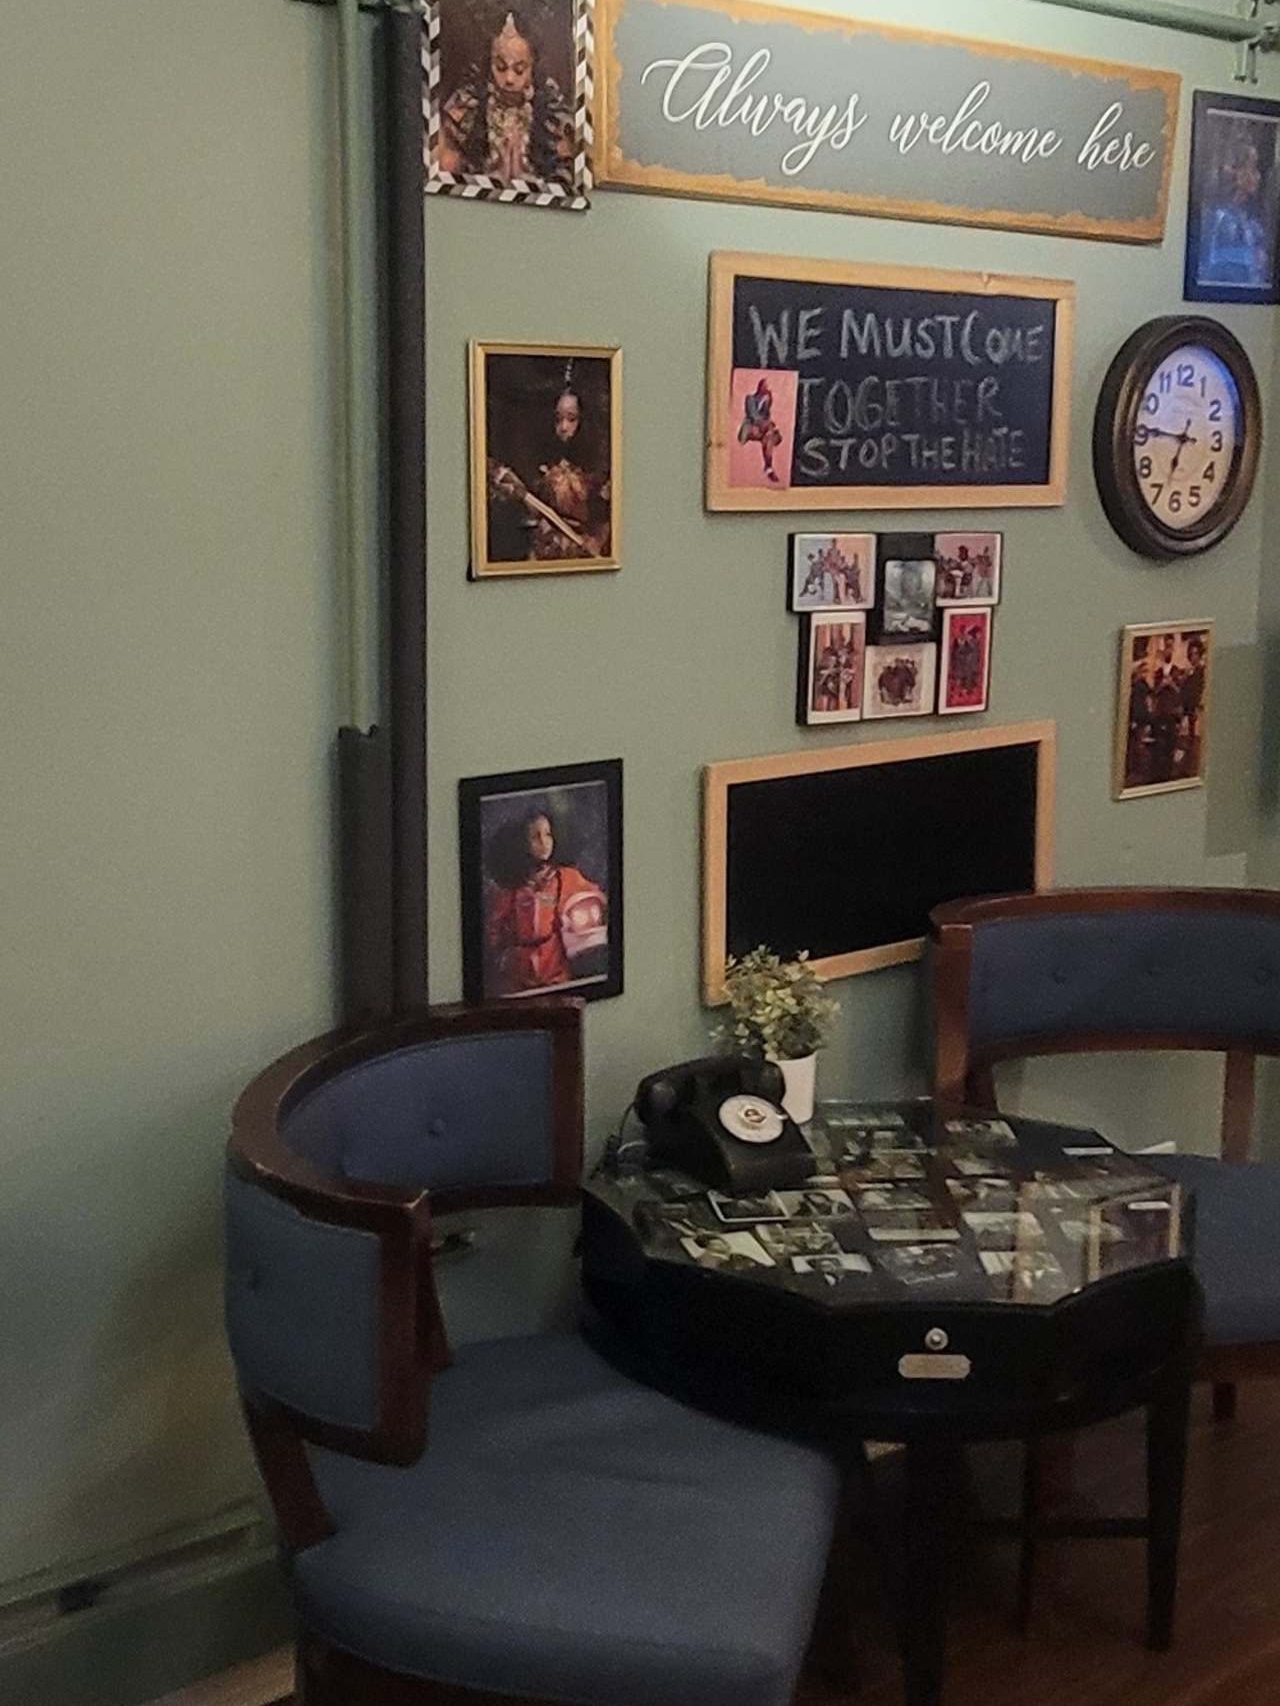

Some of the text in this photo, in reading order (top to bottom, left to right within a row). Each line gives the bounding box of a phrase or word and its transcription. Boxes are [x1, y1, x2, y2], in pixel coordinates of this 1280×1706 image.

[640, 41, 1156, 176] Always welcome here
[748, 305, 823, 368] WE
[839, 308, 960, 360] MUST
[1159, 371, 1171, 394] 11
[1176, 364, 1195, 387] 12
[1200, 376, 1207, 397] 1
[798, 376, 1004, 435] TOGETHER
[1208, 400, 1222, 421] 2
[1134, 424, 1149, 446] 9
[1211, 431, 1223, 452] 3
[800, 426, 1024, 477] STOP THE HATE
[1139, 456, 1152, 479] 8
[1202, 460, 1215, 483] 4
[1149, 483, 1164, 506] 7
[1168, 490, 1181, 513] 6
[1187, 486, 1201, 507] 5
